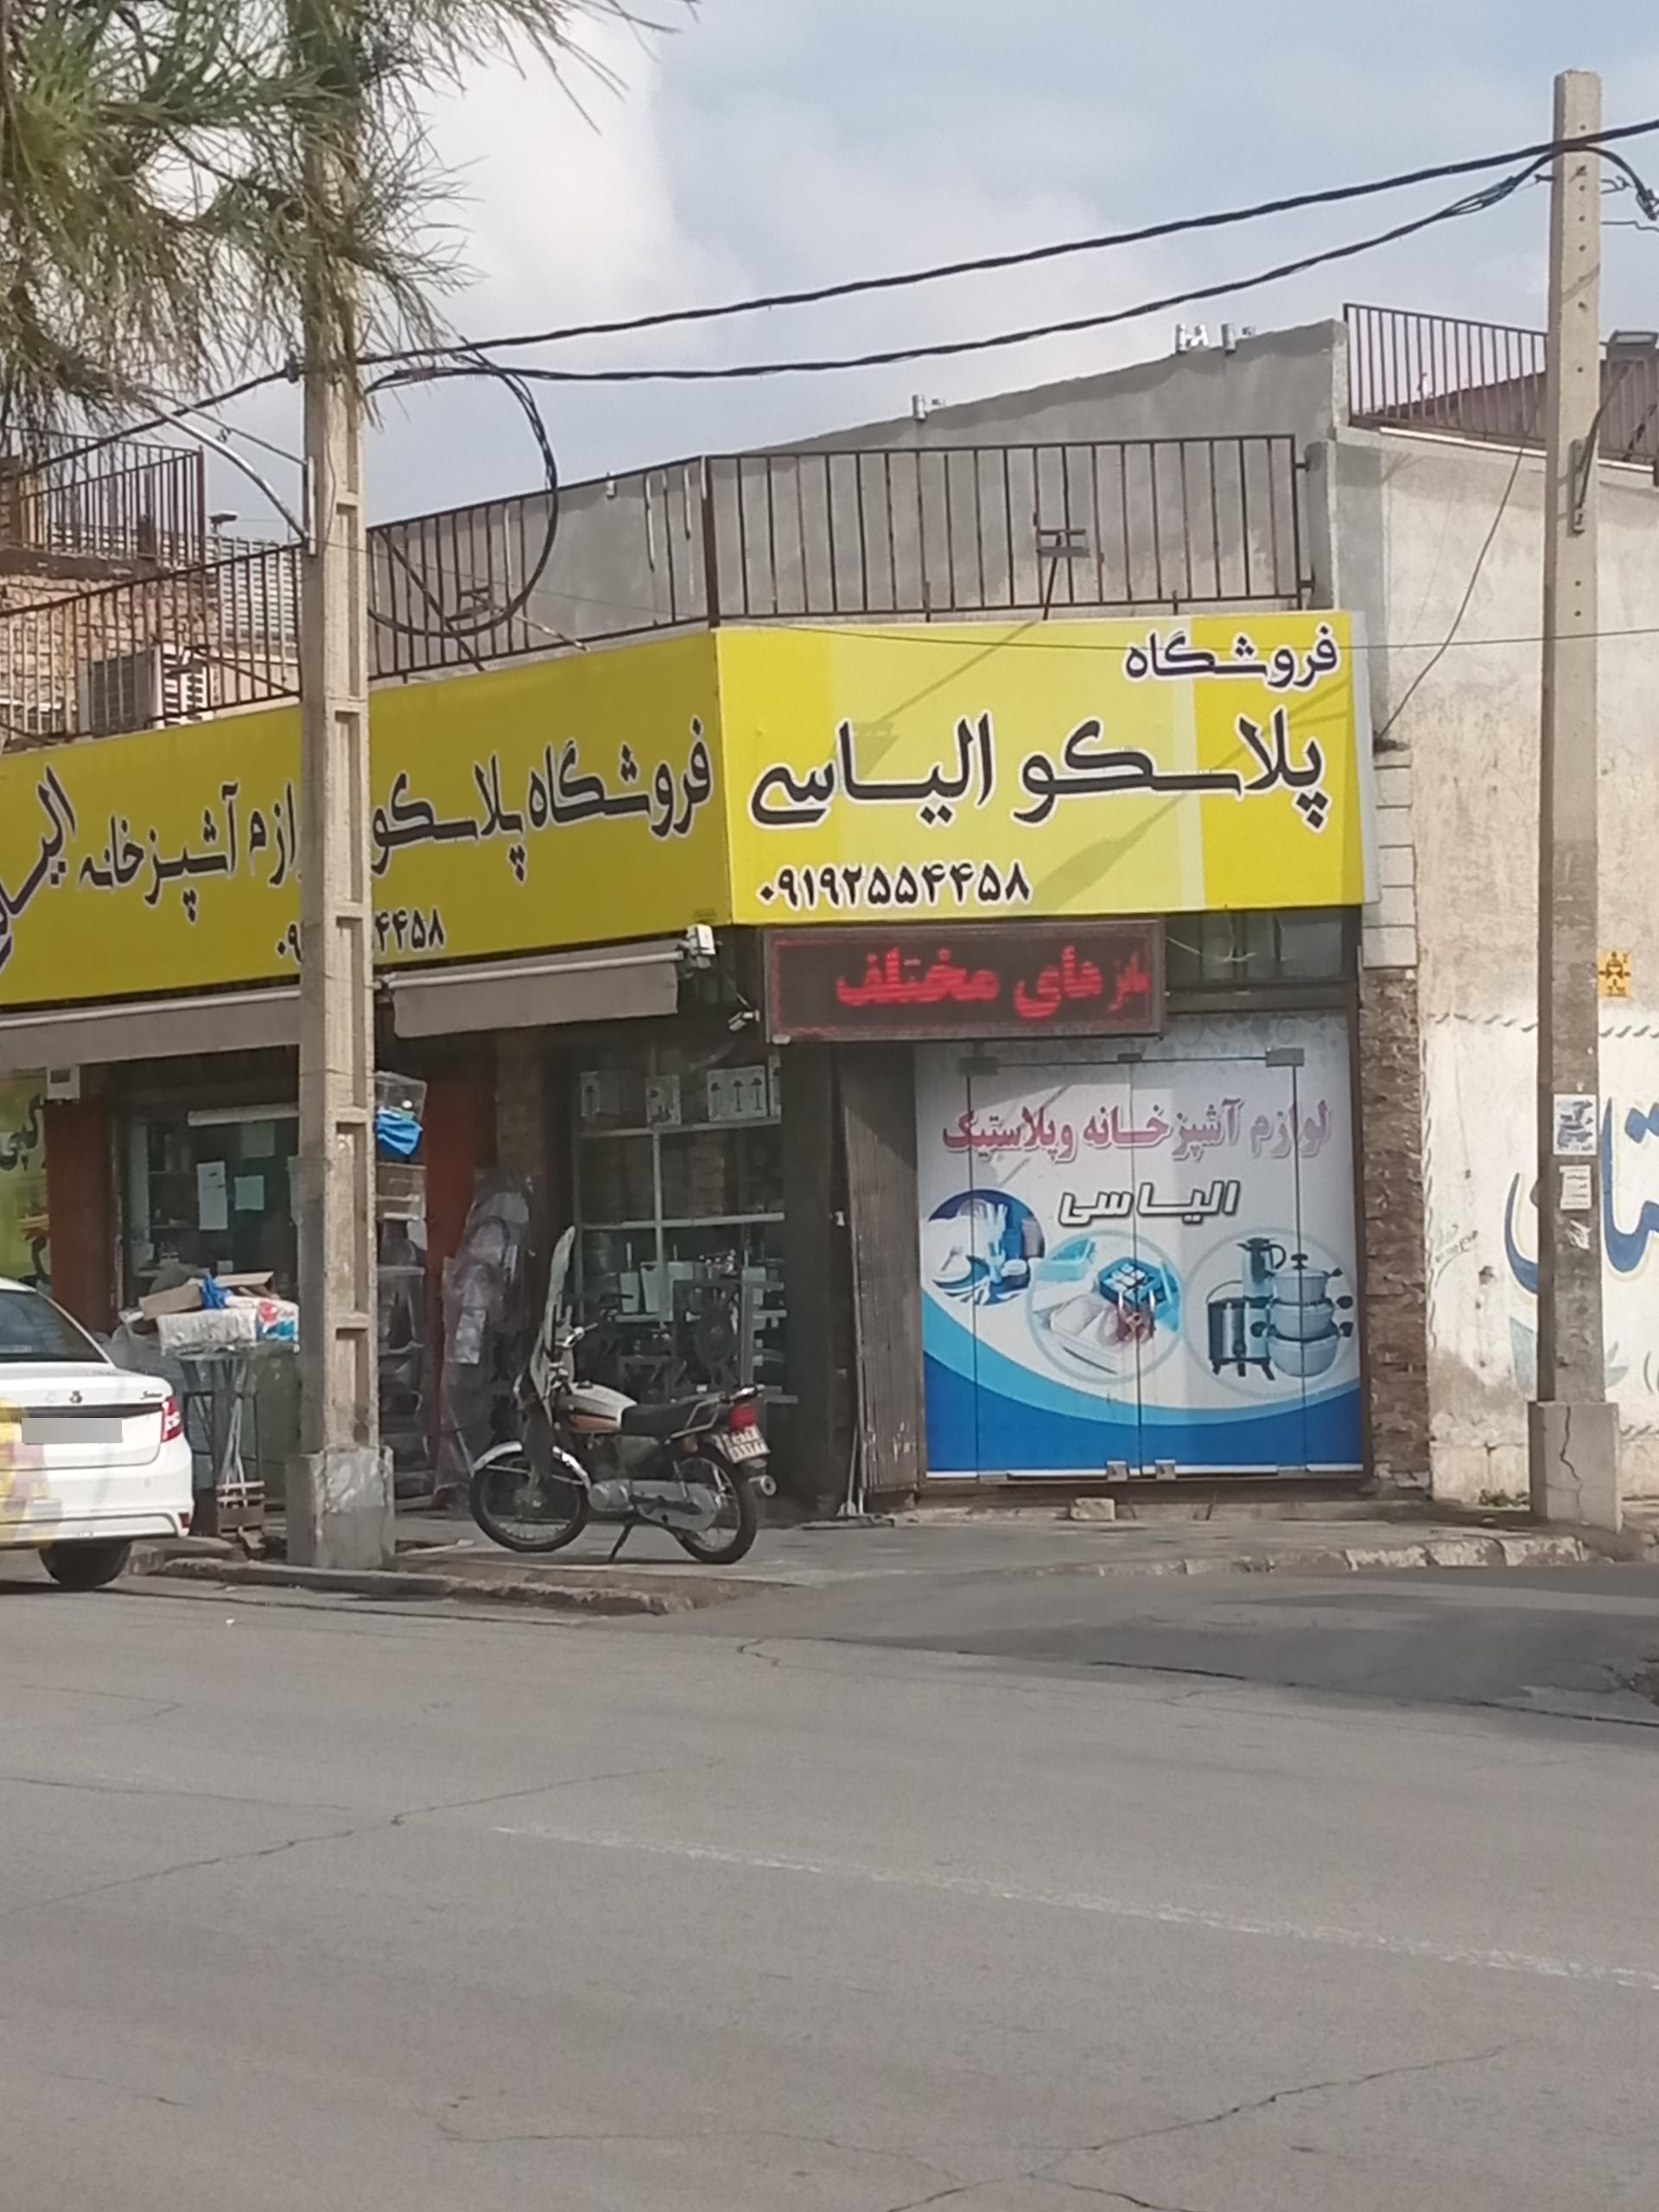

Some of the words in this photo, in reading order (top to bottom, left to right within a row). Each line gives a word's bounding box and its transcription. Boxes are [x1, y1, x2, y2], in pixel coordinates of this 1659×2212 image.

[1125, 626, 1338, 689] فروشگاه
[528, 717, 712, 837] فروشگاه
[751, 713, 993, 825] الیاسی
[1014, 708, 1328, 829] پلاسکو
[371, 754, 525, 881] پلاسکو
[760, 863, 1029, 906] ۰۹۱۹۲۵۵۴۴۵۸
[836, 947, 1001, 1007] مختلف
[1249, 1100, 1331, 1158] لوازم
[1058, 1179, 1241, 1225] الیاسی
